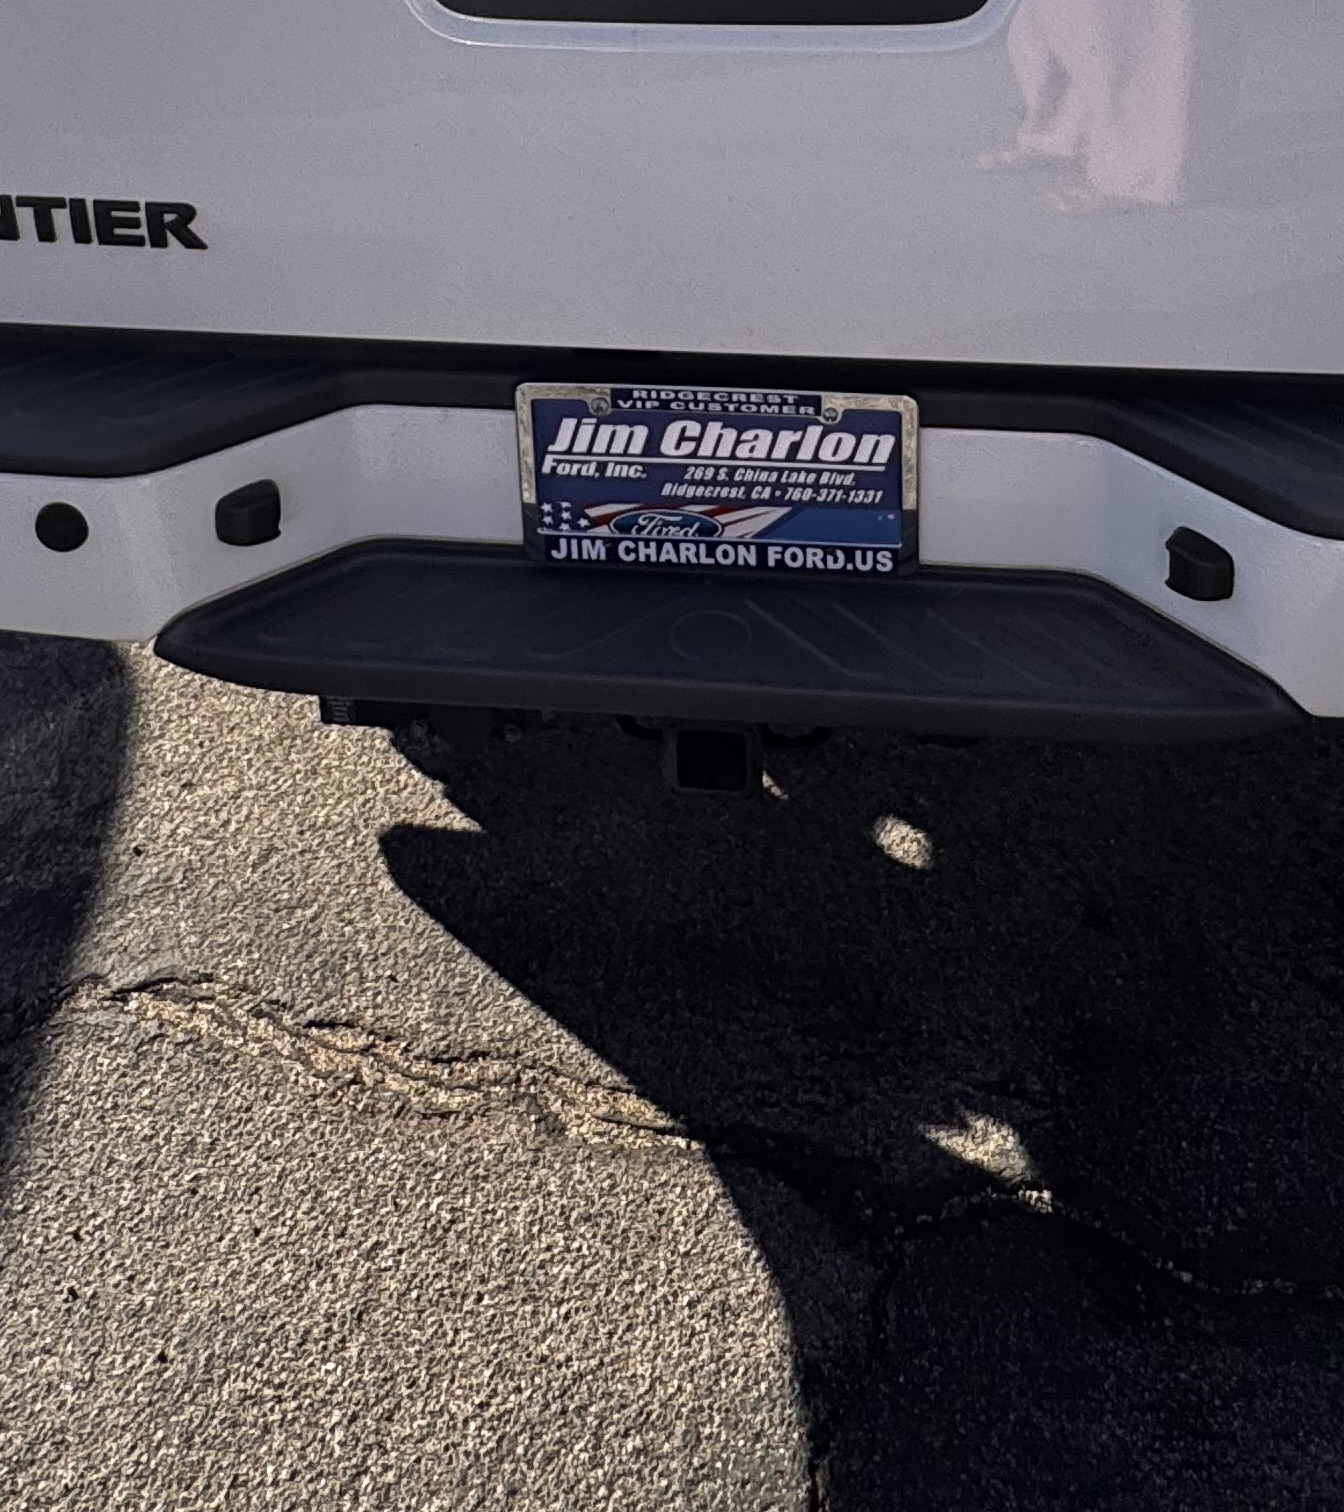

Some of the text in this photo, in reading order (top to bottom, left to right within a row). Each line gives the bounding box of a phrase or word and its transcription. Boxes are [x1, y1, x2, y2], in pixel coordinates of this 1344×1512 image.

[632, 390, 799, 404] RIDGECREST
[617, 399, 816, 416] VIP CUSTOMER
[547, 417, 896, 464] Jim Charlon
[541, 454, 648, 479] Ford, Inc.
[684, 466, 855, 486] 269 S. China Lake Blvd.
[751, 486, 772, 500] CA
[784, 488, 884, 504] 760-371-1331
[551, 538, 894, 572] JIM CHARLON FORD.US
